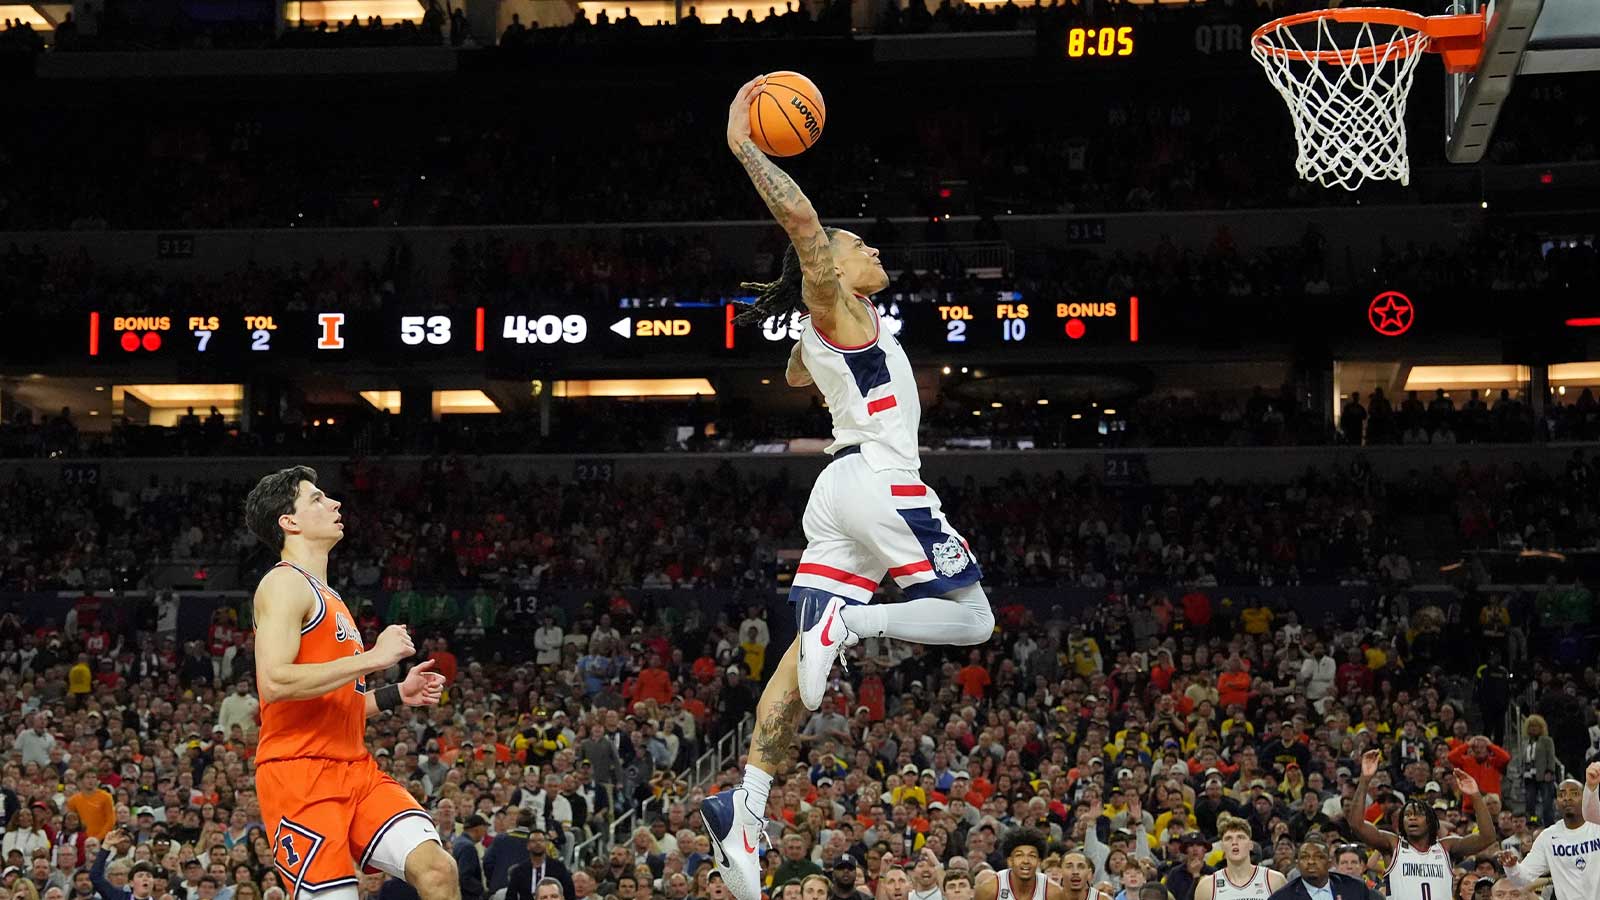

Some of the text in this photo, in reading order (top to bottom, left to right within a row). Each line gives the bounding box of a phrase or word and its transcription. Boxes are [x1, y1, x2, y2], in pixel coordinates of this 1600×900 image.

[1068, 27, 1133, 57] 8:05
[1195, 24, 1243, 54] QTR
[159, 240, 193, 255] 312
[939, 305, 973, 320] TOL
[996, 304, 1029, 319] FLS
[1056, 303, 1116, 318] BONUS
[113, 316, 171, 331] BONUS
[188, 316, 219, 331] FLS
[244, 316, 277, 330] TOL
[401, 315, 451, 345] 53
[502, 314, 588, 344] 4:09
[635, 319, 691, 337] 2ND
[947, 319, 966, 342] 2
[1003, 319, 1026, 342] 10
[194, 330, 212, 351] 7
[251, 330, 271, 351] 2
[578, 464, 611, 480] 213
[1552, 843, 1579, 857] LOCK
[1580, 841, 1589, 854] IT
